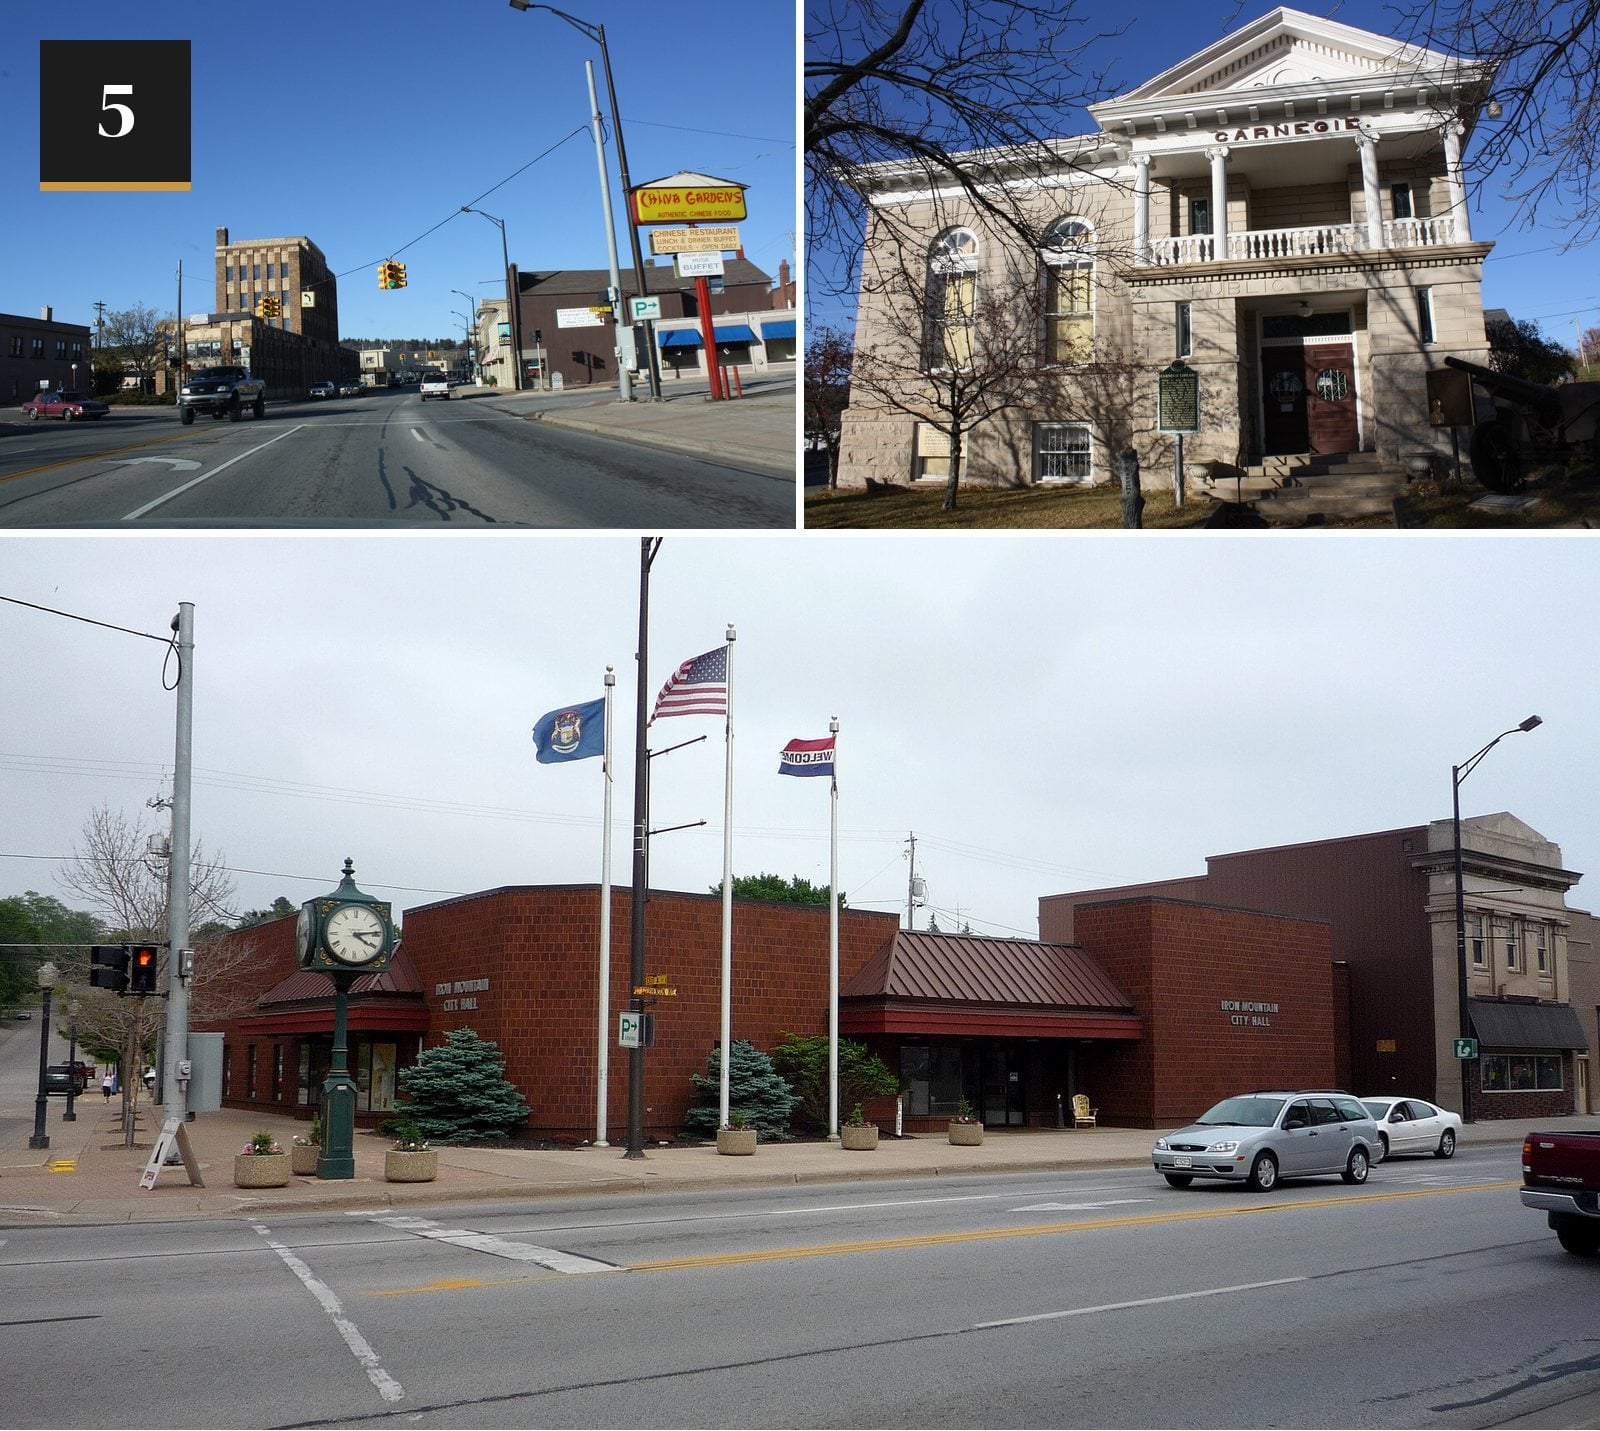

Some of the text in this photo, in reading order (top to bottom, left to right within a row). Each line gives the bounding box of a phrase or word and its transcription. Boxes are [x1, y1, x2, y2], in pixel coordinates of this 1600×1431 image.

[685, 191, 742, 205] GARDENS
[653, 227, 737, 238] CHINESE RESTAURANT
[656, 237, 678, 245] LUNCH
[688, 236, 712, 244] DINNER
[683, 262, 720, 271] BUFFET
[1191, 269, 1416, 298] PUBLIC LIBRARY
[635, 301, 647, 316] P
[1221, 1000, 1279, 1013] IRON MOUNTAIN
[1231, 1015, 1271, 1027] CITY HALL
[622, 1018, 631, 1041] P
